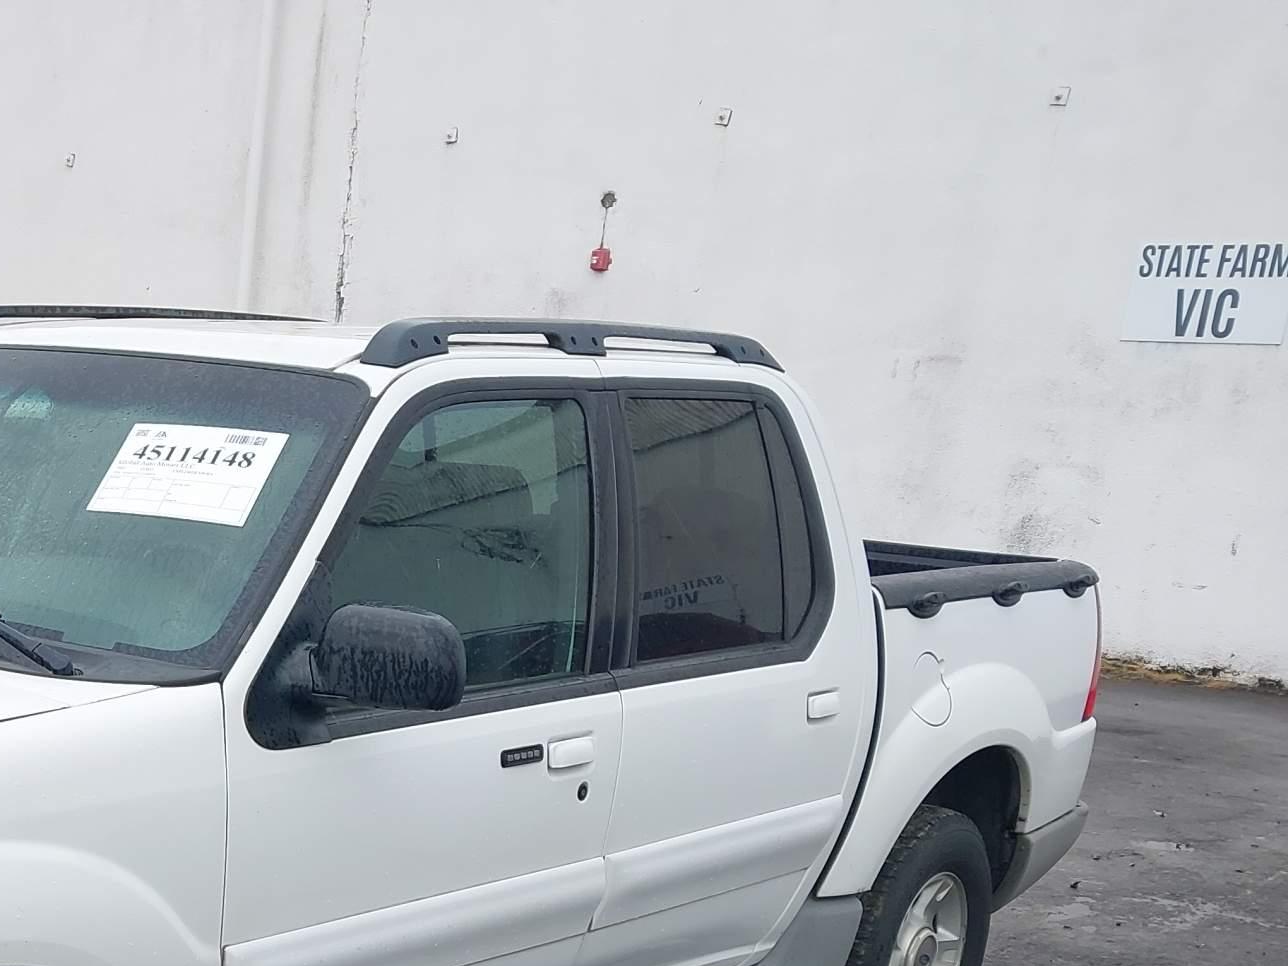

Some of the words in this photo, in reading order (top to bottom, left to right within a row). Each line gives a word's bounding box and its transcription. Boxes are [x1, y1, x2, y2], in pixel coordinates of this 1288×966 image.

[1139, 244, 1213, 278] STATE
[1216, 244, 1288, 278] FARM
[1174, 288, 1240, 339] VIC
[132, 443, 256, 469] 45114148
